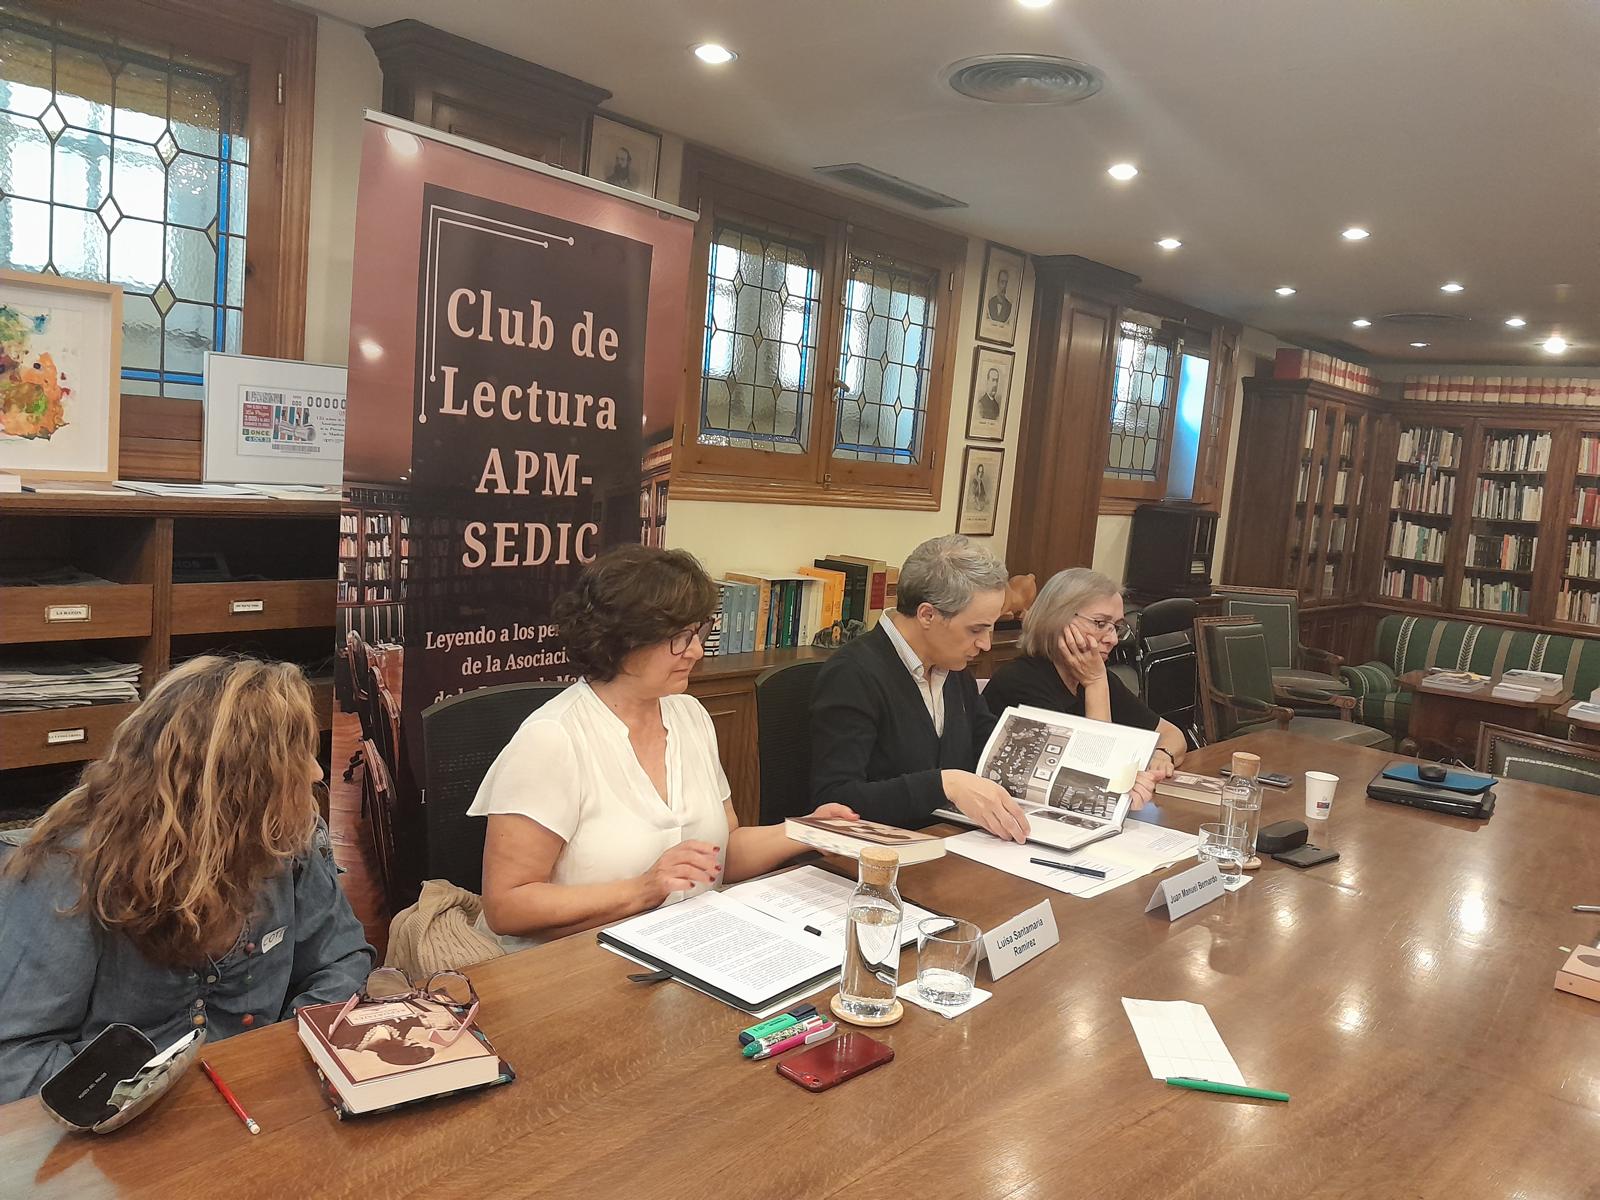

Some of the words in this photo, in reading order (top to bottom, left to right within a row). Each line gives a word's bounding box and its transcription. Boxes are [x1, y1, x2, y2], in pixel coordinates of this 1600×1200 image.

[447, 288, 555, 351] Club
[571, 310, 619, 361] de
[439, 365, 617, 430] Lectura
[475, 447, 593, 497] APM-
[462, 521, 599, 568] SEDIC
[425, 626, 496, 652] Leyendo
[500, 628, 510, 642] a
[513, 623, 535, 641] los
[462, 657, 482, 676] de
[485, 655, 502, 673] la
[505, 646, 570, 671] Asociaci
[1181, 882, 1199, 898] Manuel
[996, 934, 1014, 950] Luisa
